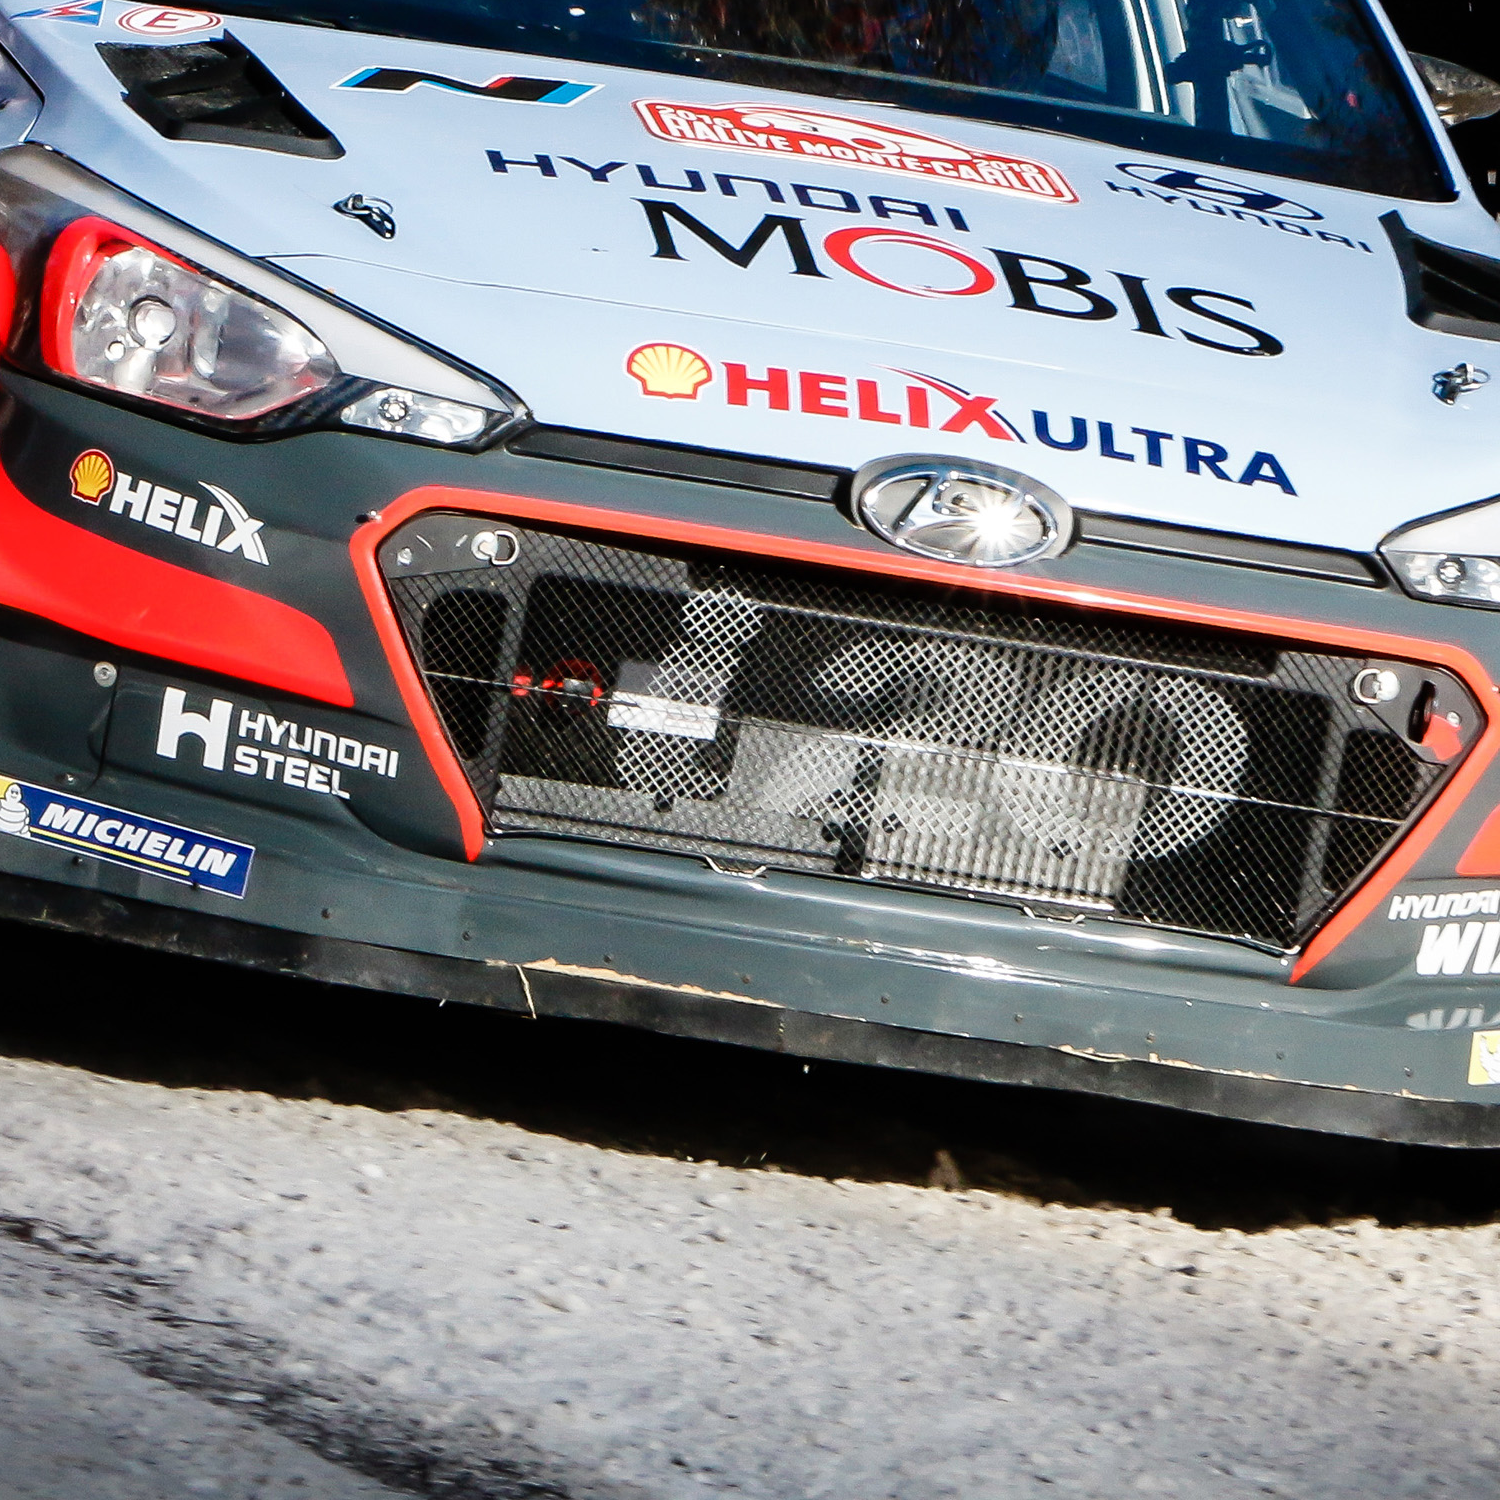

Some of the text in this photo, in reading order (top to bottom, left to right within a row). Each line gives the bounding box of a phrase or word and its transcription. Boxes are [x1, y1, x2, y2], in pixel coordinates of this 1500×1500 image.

[143, 10, 198, 30] E
[656, 104, 733, 129] 2016
[664, 112, 1054, 195] RALLYE MONTE-CARLO
[486, 149, 970, 233] HYUNDAI
[1103, 180, 1373, 253] HYUNDAI
[634, 198, 1284, 358] MOBIS
[722, 364, 1299, 497] HELIX ULTRA
[109, 472, 270, 566] HELIX
[233, 746, 351, 800] STEEL
[238, 708, 399, 779] HYUNDAI
[40, 802, 238, 878] MICHELIN
[1388, 889, 1500, 921] HYUNDAI
